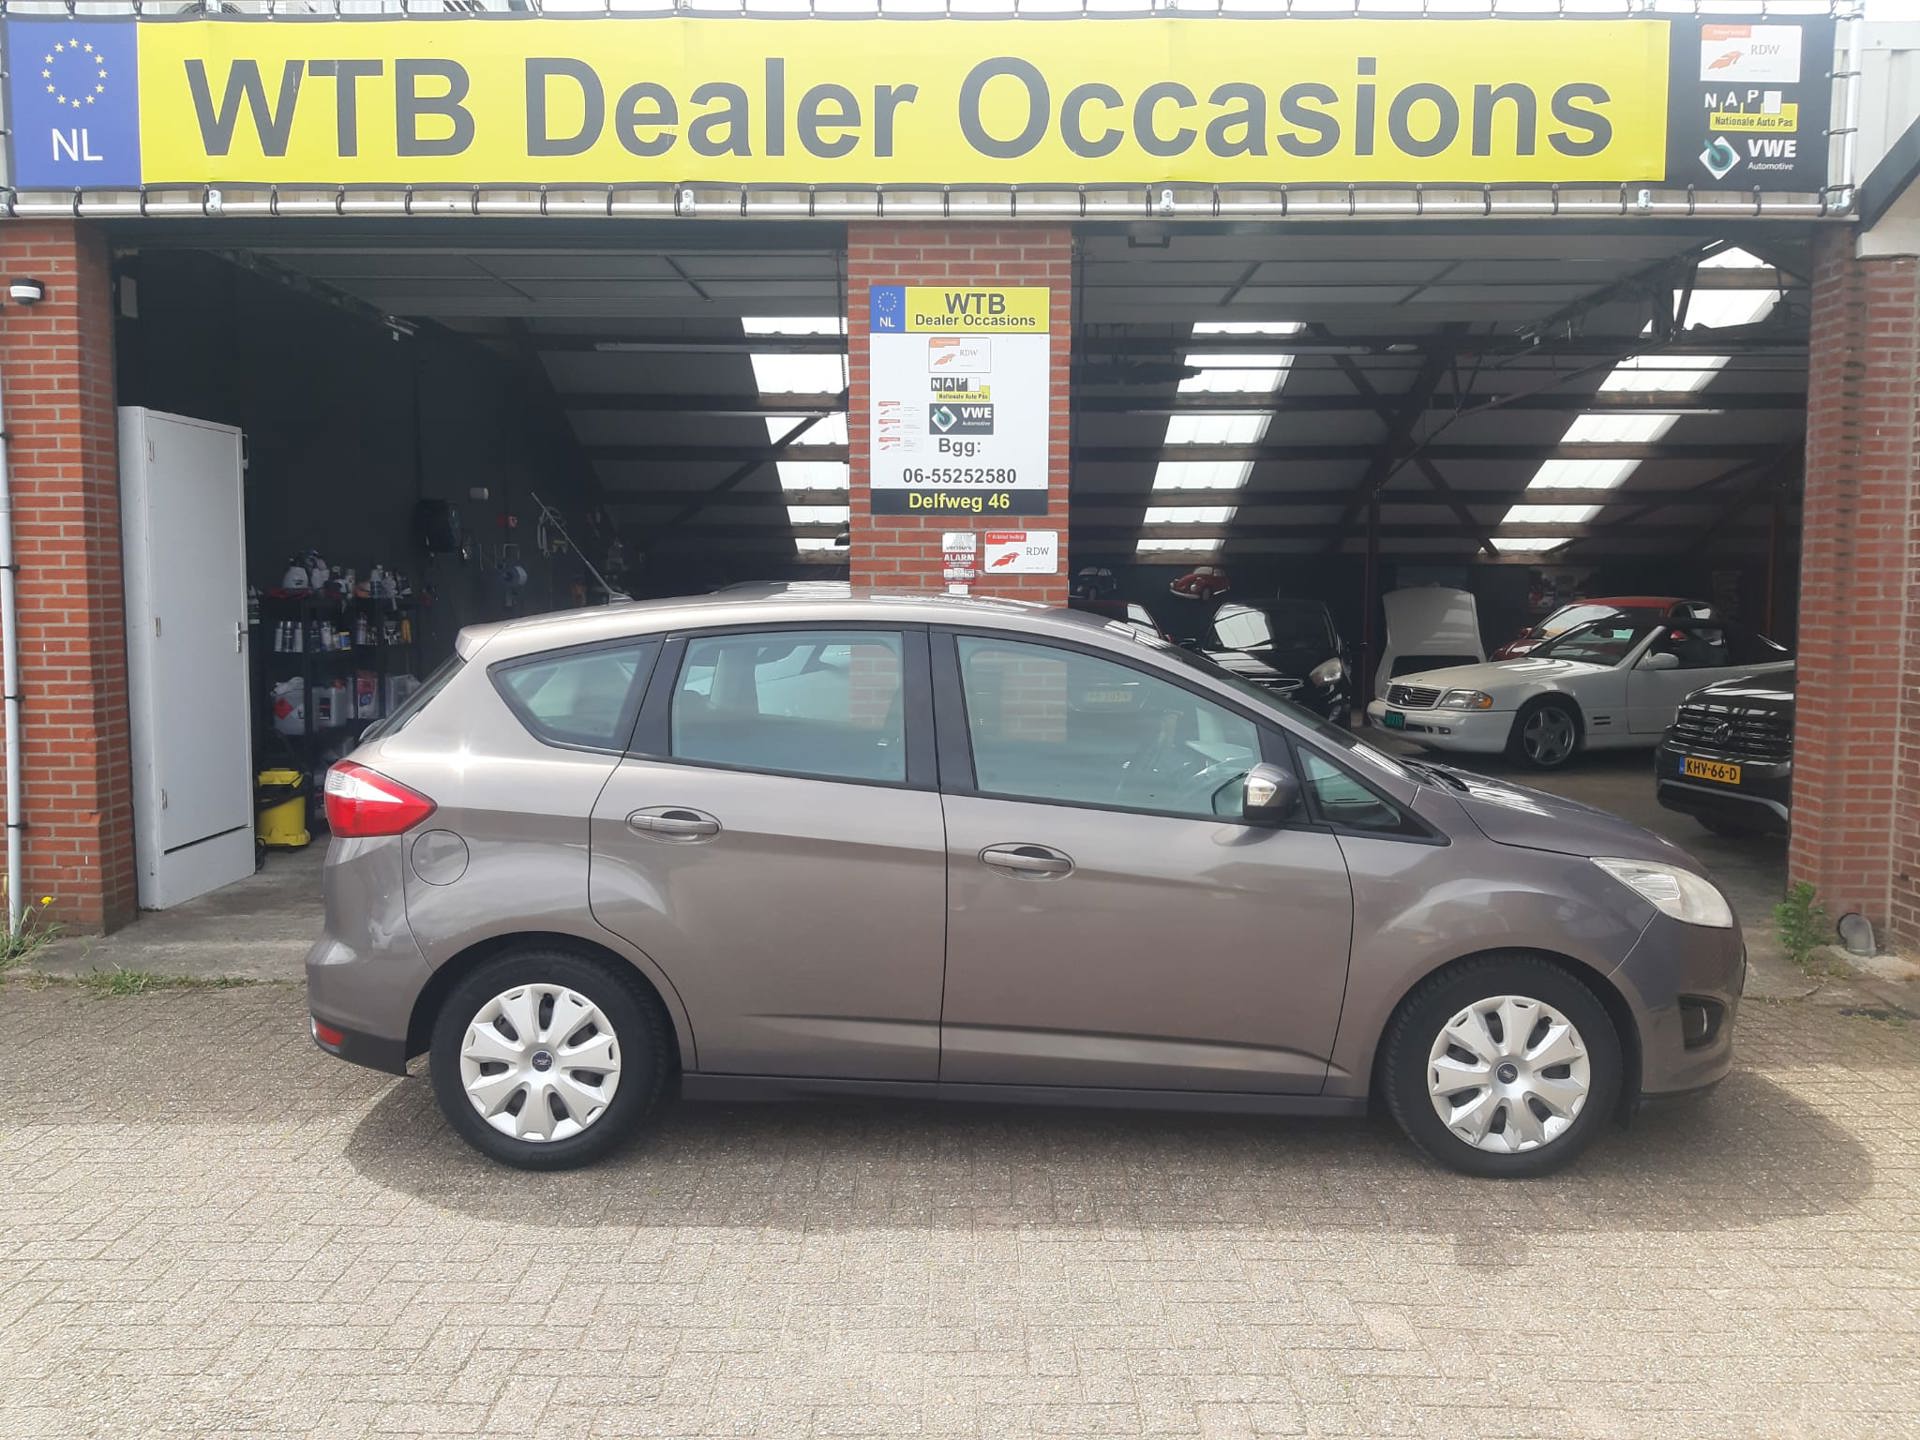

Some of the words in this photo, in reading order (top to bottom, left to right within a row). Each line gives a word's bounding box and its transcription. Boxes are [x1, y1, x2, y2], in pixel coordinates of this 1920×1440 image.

[1750, 44, 1781, 56] RDW
[184, 58, 476, 158] WTB
[525, 57, 919, 159] Dealer
[958, 56, 1616, 159] Occasions
[1715, 116, 1755, 127] Nationale
[1757, 117, 1776, 127] Auto
[1778, 118, 1794, 128] Pas
[51, 128, 104, 162] NL
[1748, 139, 1797, 158] VWE
[1747, 162, 1795, 171] Automotive
[945, 293, 1006, 315] WTB
[879, 316, 896, 328] NL
[915, 313, 959, 326] Dealer
[963, 313, 1036, 327] Occasions
[961, 406, 992, 419] VWE
[938, 437, 982, 458] Bgg:
[902, 468, 1017, 484] 06-55252580
[909, 492, 983, 513] Delfweg
[988, 493, 1011, 509] 46
[944, 553, 975, 562] ALARM
[1025, 546, 1050, 557] RDW
[1686, 759, 1737, 781] KHV-66-D
